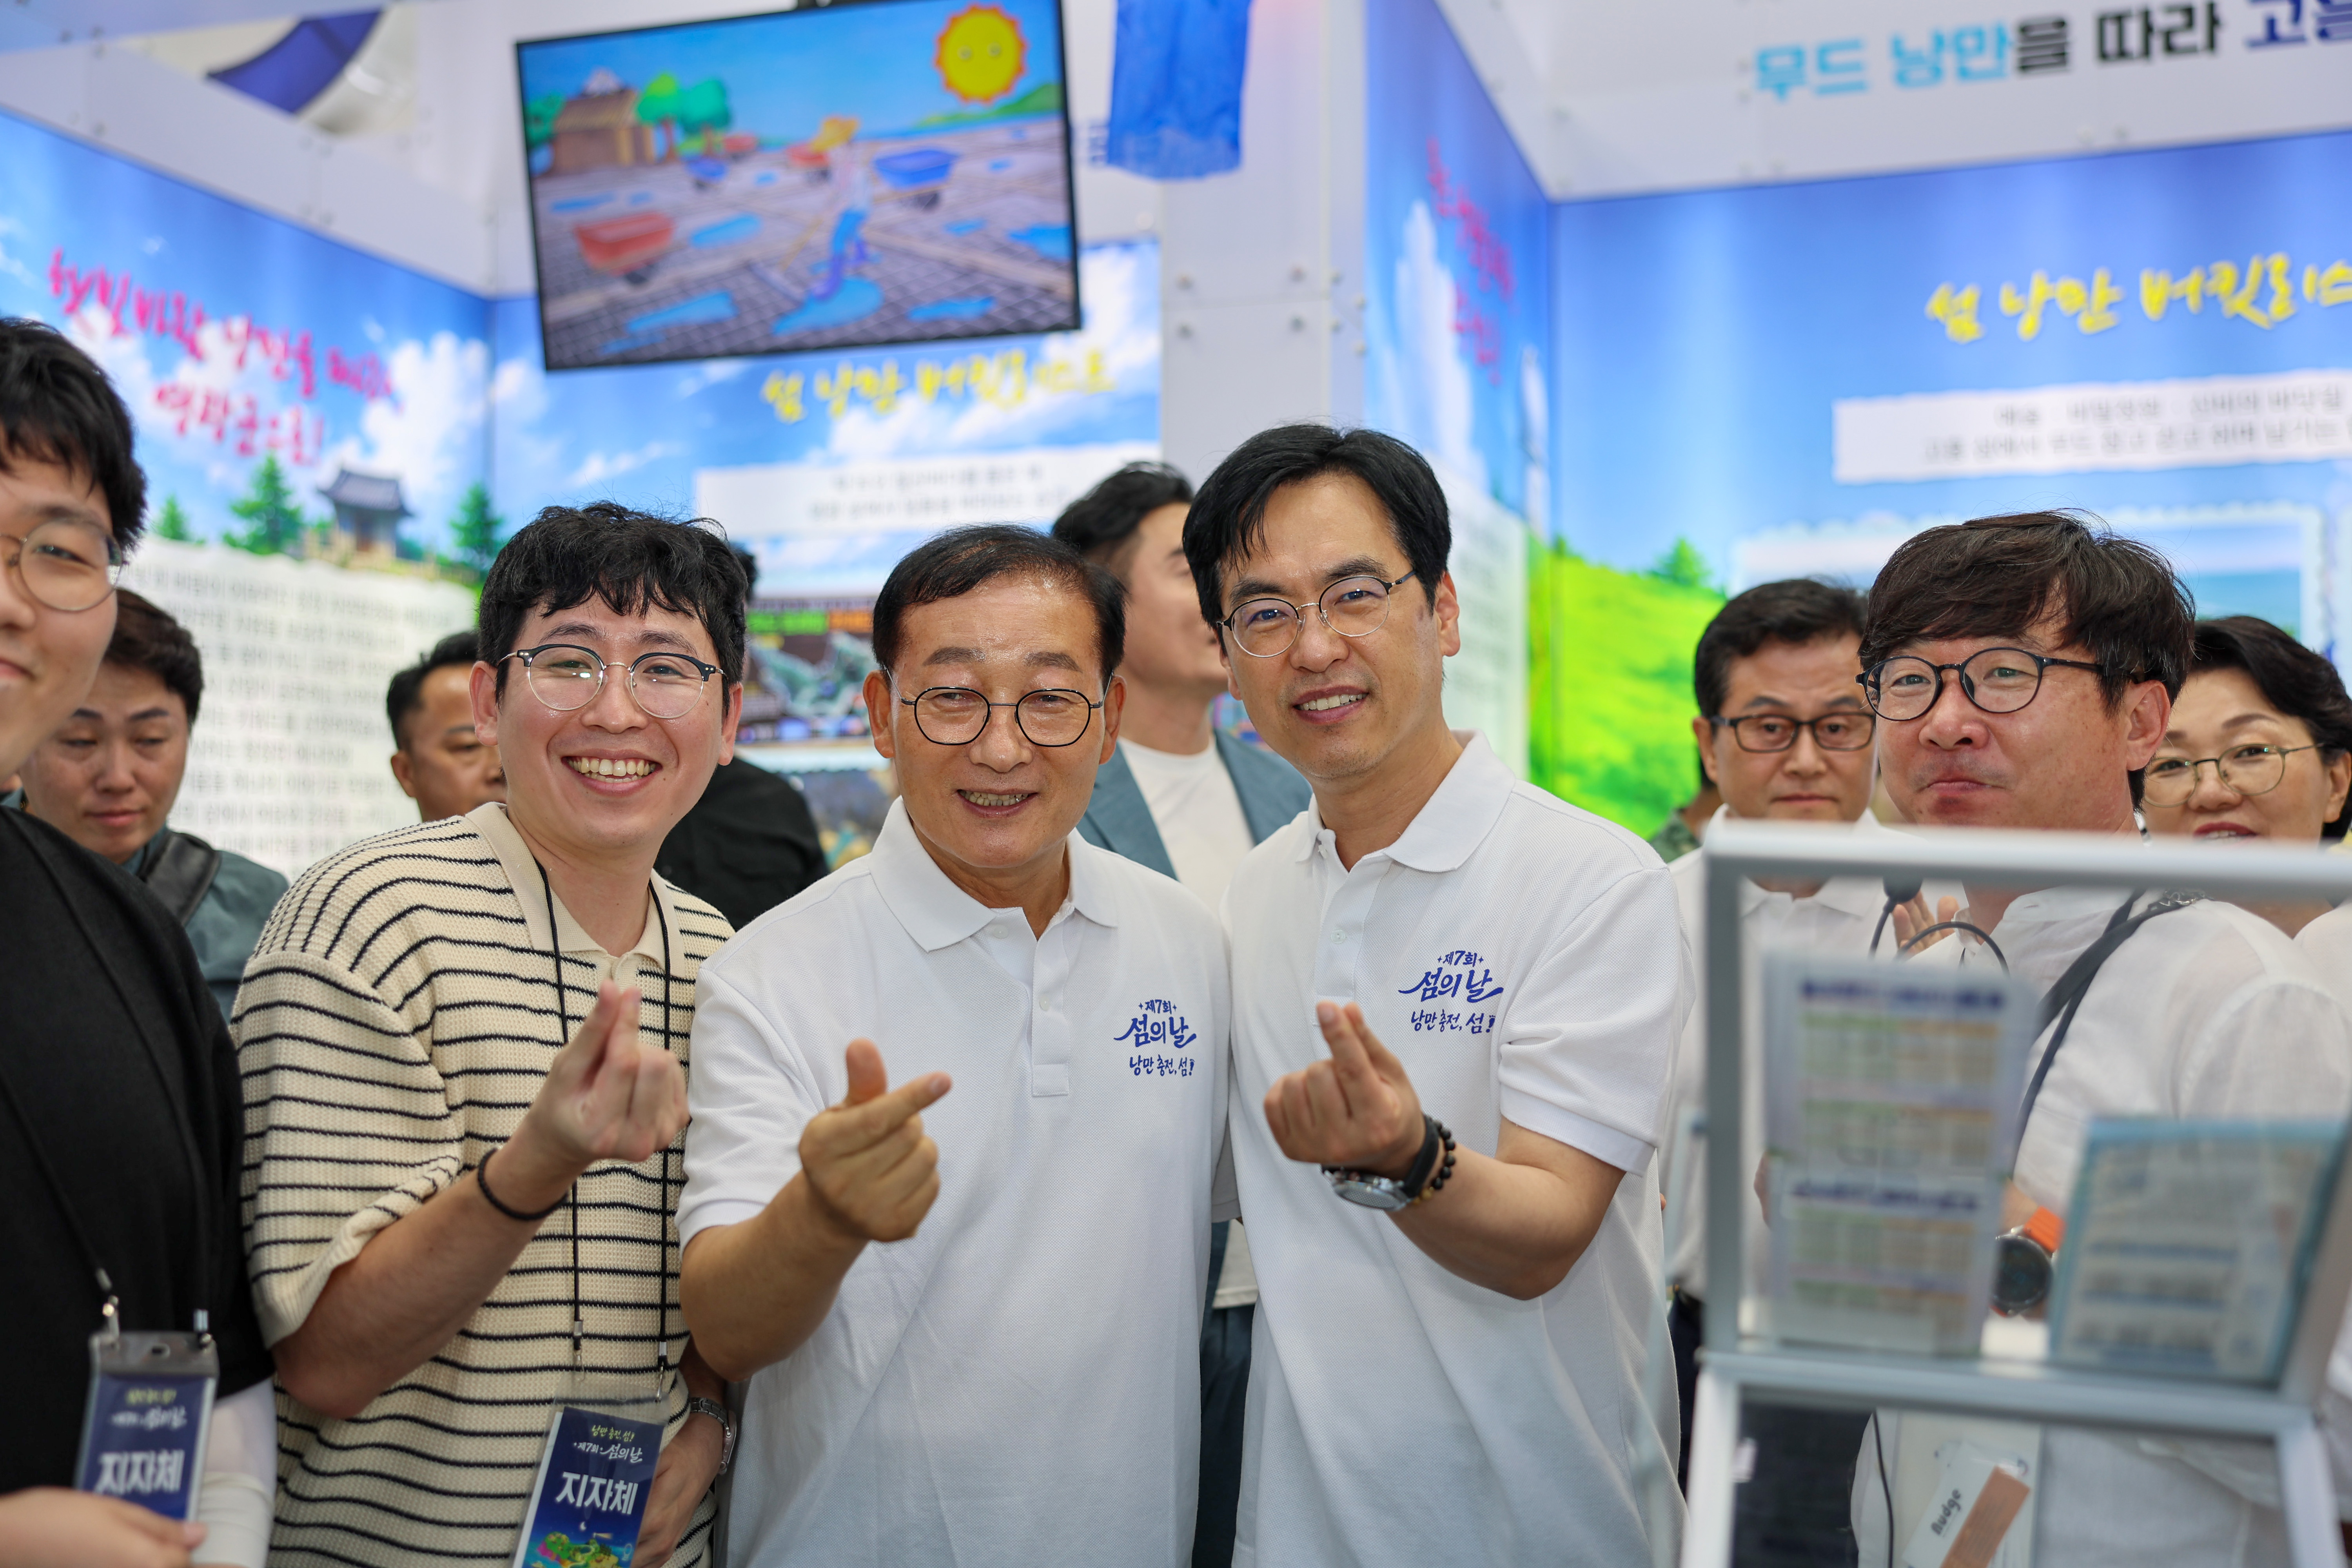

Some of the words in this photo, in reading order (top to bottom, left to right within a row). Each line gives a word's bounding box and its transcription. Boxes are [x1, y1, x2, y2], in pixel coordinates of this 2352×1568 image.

[1755, 39, 1869, 102] 무드
[1890, 16, 2071, 89] 낭만을
[2094, 1, 2223, 67] 따라
[1925, 281, 1986, 344] 섬
[1998, 267, 2124, 341] 낭만
[760, 368, 808, 424] 섬
[813, 358, 909, 422] 낭만
[1443, 950, 1477, 967] 제7회
[1145, 999, 1172, 1014] 제7회
[1411, 1009, 1437, 1031] 낭만
[1439, 1009, 1462, 1032] 충전,
[1466, 1013, 1496, 1034] 섬!
[1129, 1054, 1154, 1076] 낭만
[1156, 1054, 1177, 1076] 충전,
[1178, 1057, 1195, 1077] 섬!
[592, 1425, 608, 1437] 낭만
[622, 1430, 635, 1442] 섬!
[577, 1442, 599, 1454] 제7회
[94, 1449, 186, 1495] 지자체
[556, 1471, 639, 1515] 지자체
